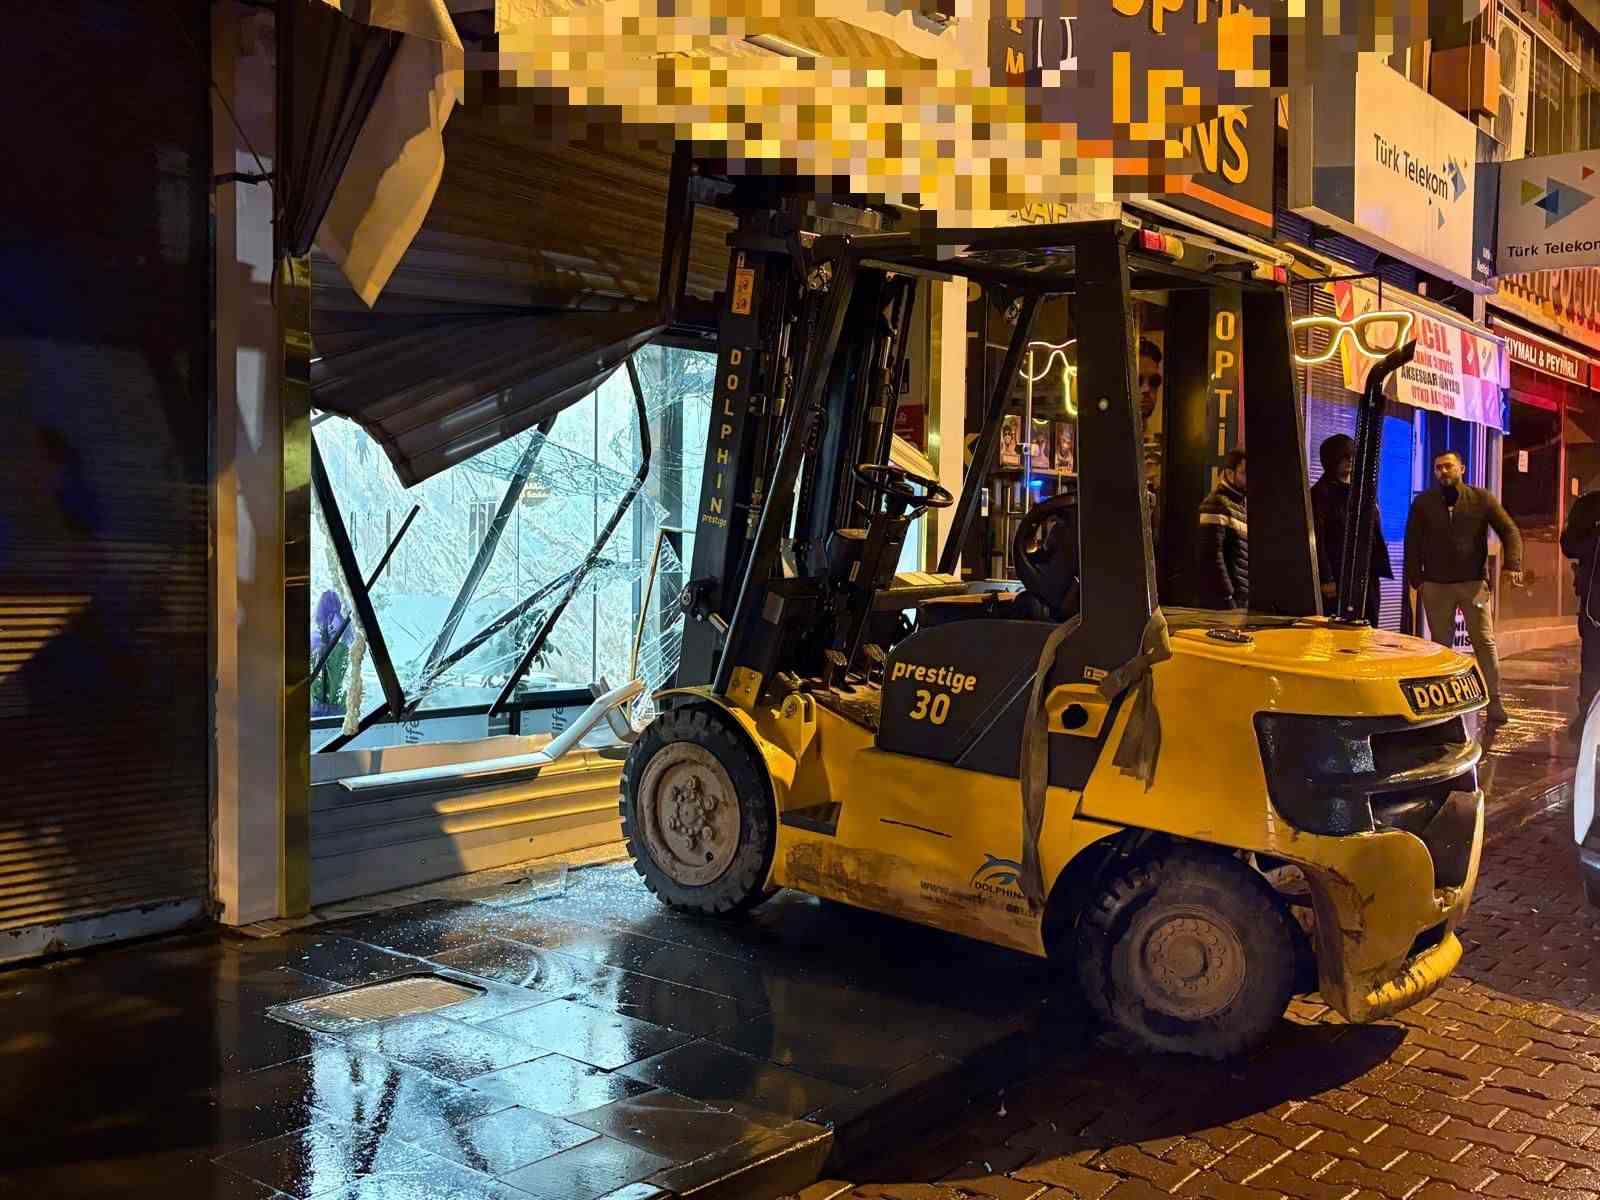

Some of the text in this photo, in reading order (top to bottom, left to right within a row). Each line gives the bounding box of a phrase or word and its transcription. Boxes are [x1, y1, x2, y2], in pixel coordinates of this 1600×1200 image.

[1373, 132, 1448, 200] Türk Telekom
[1508, 244, 1539, 257] Türk
[1504, 336, 1537, 363] KIYMALI
[1538, 350, 1545, 367] &
[711, 349, 741, 513] DOLPHIN
[892, 661, 977, 691] prestige
[1413, 674, 1483, 708] DOLPHIN
[909, 689, 951, 725] 30
